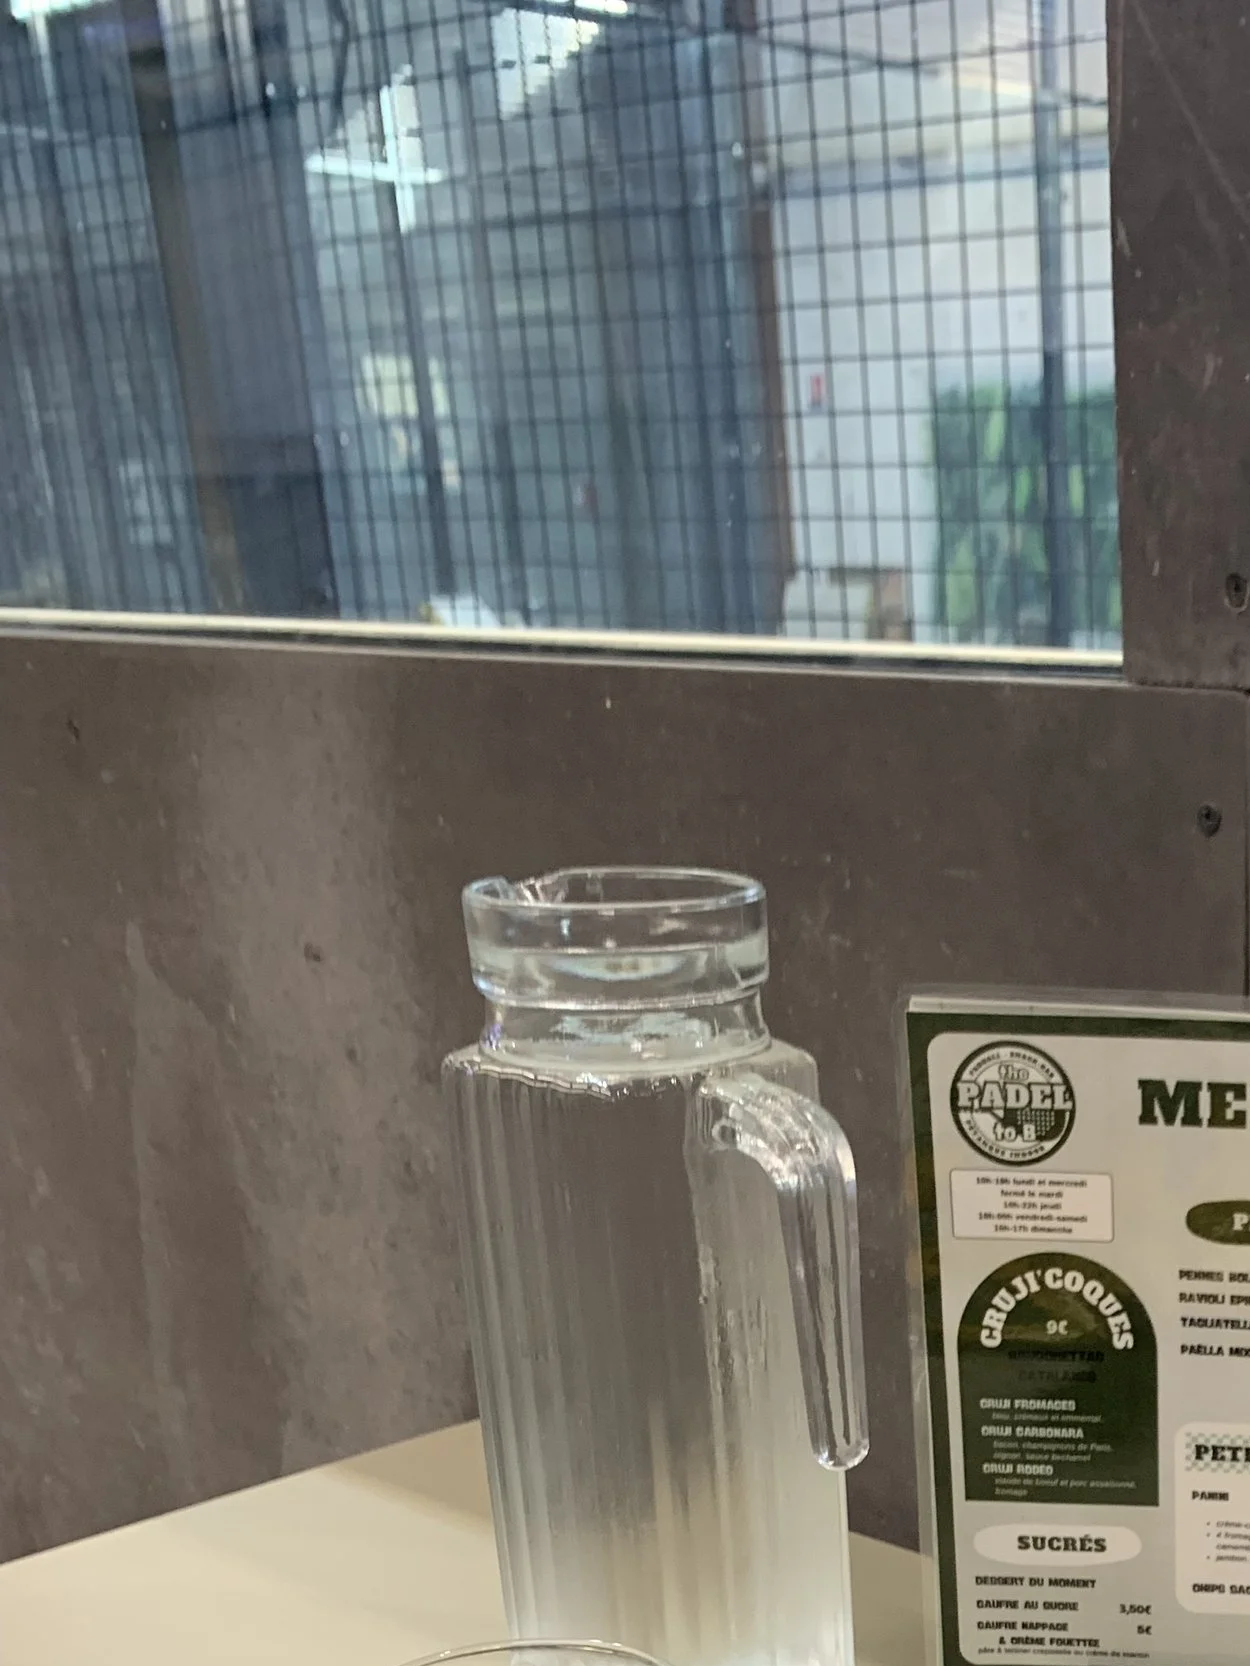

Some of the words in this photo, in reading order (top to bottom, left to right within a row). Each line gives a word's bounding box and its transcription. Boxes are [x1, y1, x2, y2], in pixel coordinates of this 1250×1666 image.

[998, 1064, 1029, 1081] the
[957, 1081, 1073, 1109] PADEL
[994, 1122, 1016, 1141] to
[1013, 1178, 1035, 1186] lundi
[1038, 1178, 1046, 1186] et
[1049, 1180, 1087, 1188] mercredi
[1000, 1190, 1025, 1198] fermé
[1038, 1191, 1063, 1199] mardi
[1040, 1203, 1061, 1212] jeudi
[1030, 1226, 1072, 1234] dimanche
[1178, 1269, 1223, 1282] PENNES
[1179, 1292, 1225, 1305] RAVIOLI
[980, 1267, 1134, 1350] CRUJI'COQUES
[1046, 1320, 1068, 1335] 9€
[980, 1398, 1011, 1409] CRUJI
[1014, 1399, 1076, 1411] FROMAGES
[981, 1425, 1012, 1437] CRUJI
[1015, 1426, 1084, 1438] CARBONARA
[1022, 1441, 1075, 1450] champignons
[982, 1463, 1013, 1474] CRUJI
[1016, 1464, 1053, 1476] RODEO
[1069, 1480, 1088, 1488] porc
[1192, 1490, 1229, 1501] PANINI
[1017, 1534, 1107, 1553] SUCRÉS
[975, 1576, 1025, 1586] DESSERT
[1029, 1577, 1044, 1586] DU
[1048, 1578, 1096, 1588] MOMENT
[1192, 1583, 1225, 1594] CHIPS
[976, 1600, 1019, 1609] GAUFRE
[1024, 1601, 1038, 1610] AU
[1043, 1601, 1079, 1611] SUCRE
[1119, 1604, 1152, 1615] 3,50€
[977, 1621, 1017, 1630] GAUFRE
[1021, 1622, 1068, 1632] NAPPAGE
[1137, 1625, 1152, 1635] 5€
[999, 1636, 1006, 1645] &
